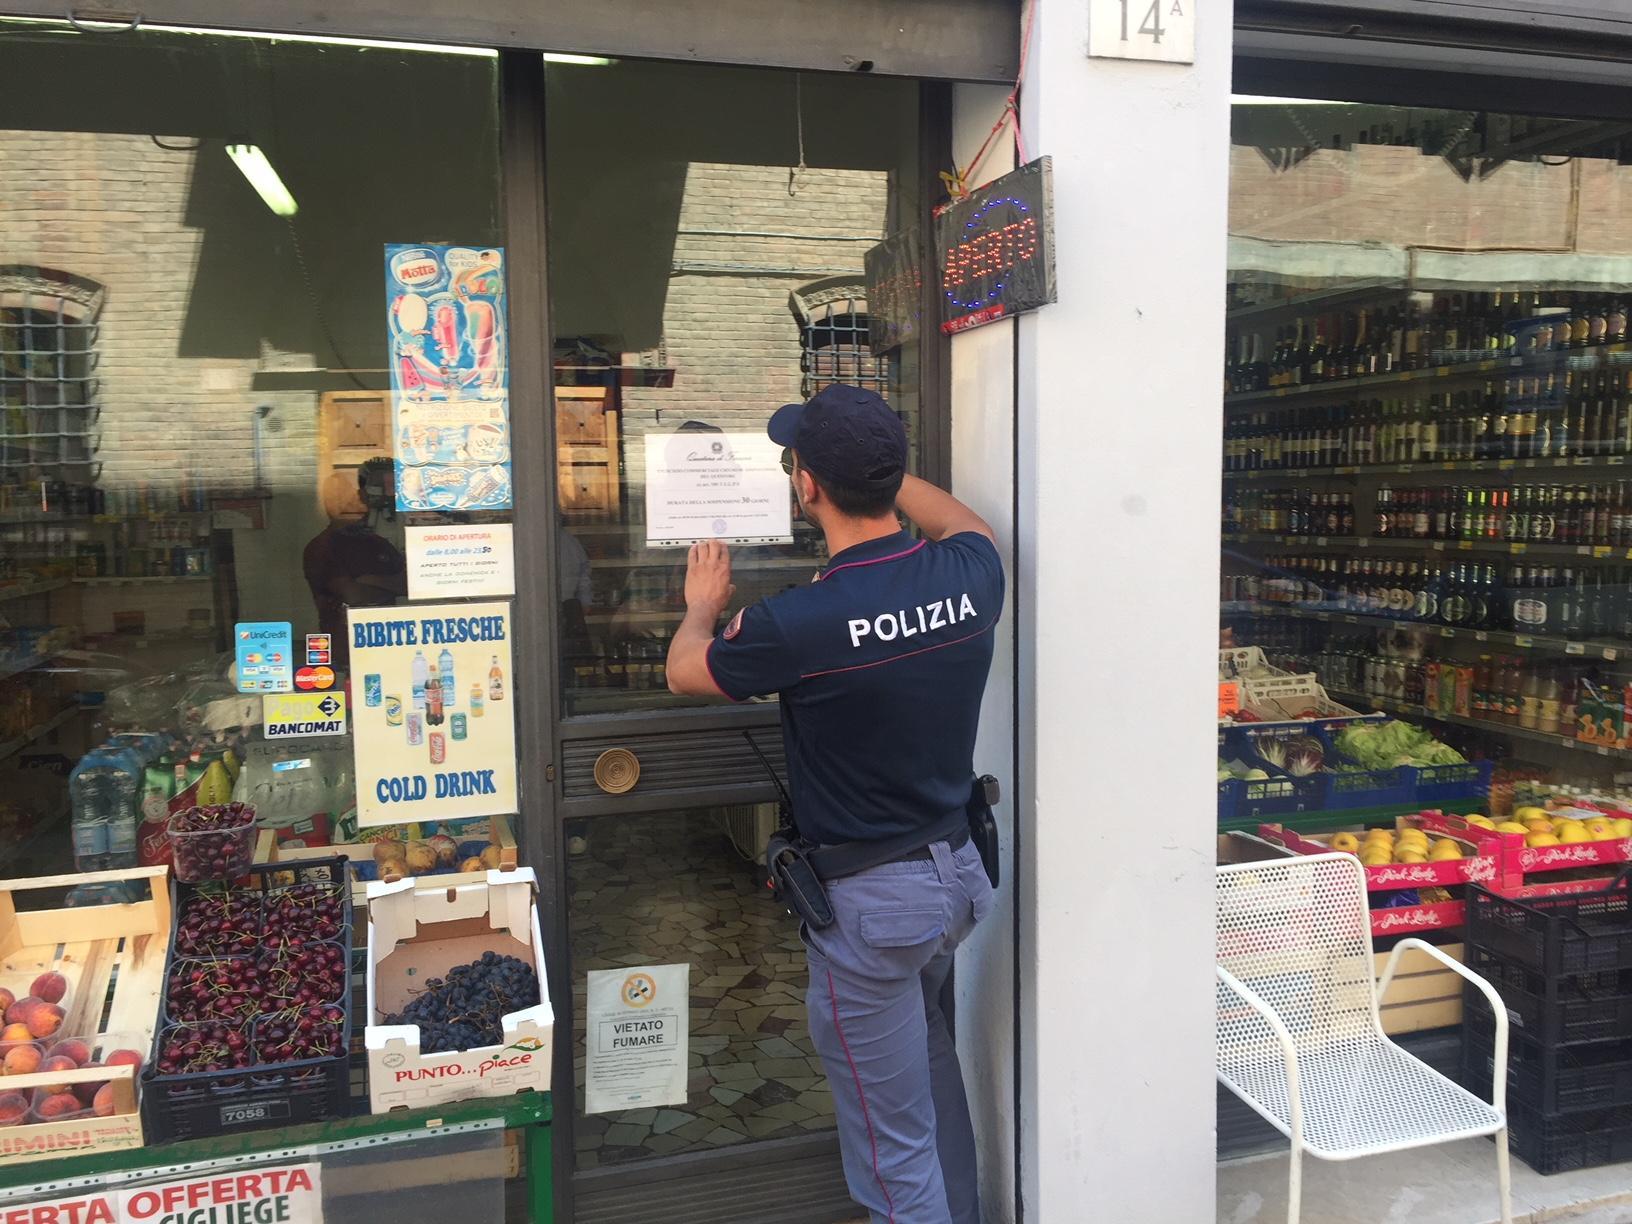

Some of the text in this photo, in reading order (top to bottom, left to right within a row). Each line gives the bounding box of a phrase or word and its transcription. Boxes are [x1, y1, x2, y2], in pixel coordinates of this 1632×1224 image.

[1117, 0, 1166, 44] 14
[942, 216, 1037, 289] APERTO
[401, 264, 436, 280] Motta
[741, 496, 750, 504] 30
[352, 615, 505, 648] BIBITE FRESCHE
[847, 593, 977, 647] POLIZIA
[250, 630, 287, 639] UniCredit
[268, 721, 342, 735] BANCOMAT
[376, 770, 496, 803] COLD DRINK
[614, 1020, 664, 1034] VIETATO
[613, 1034, 664, 1048] FUMARE
[479, 1053, 532, 1077] piace
[226, 1108, 265, 1121] 7058
[0, 1130, 91, 1152] IMINI
[127, 1168, 313, 1219] OFFERTA
[0, 1198, 118, 1224] ERTA
